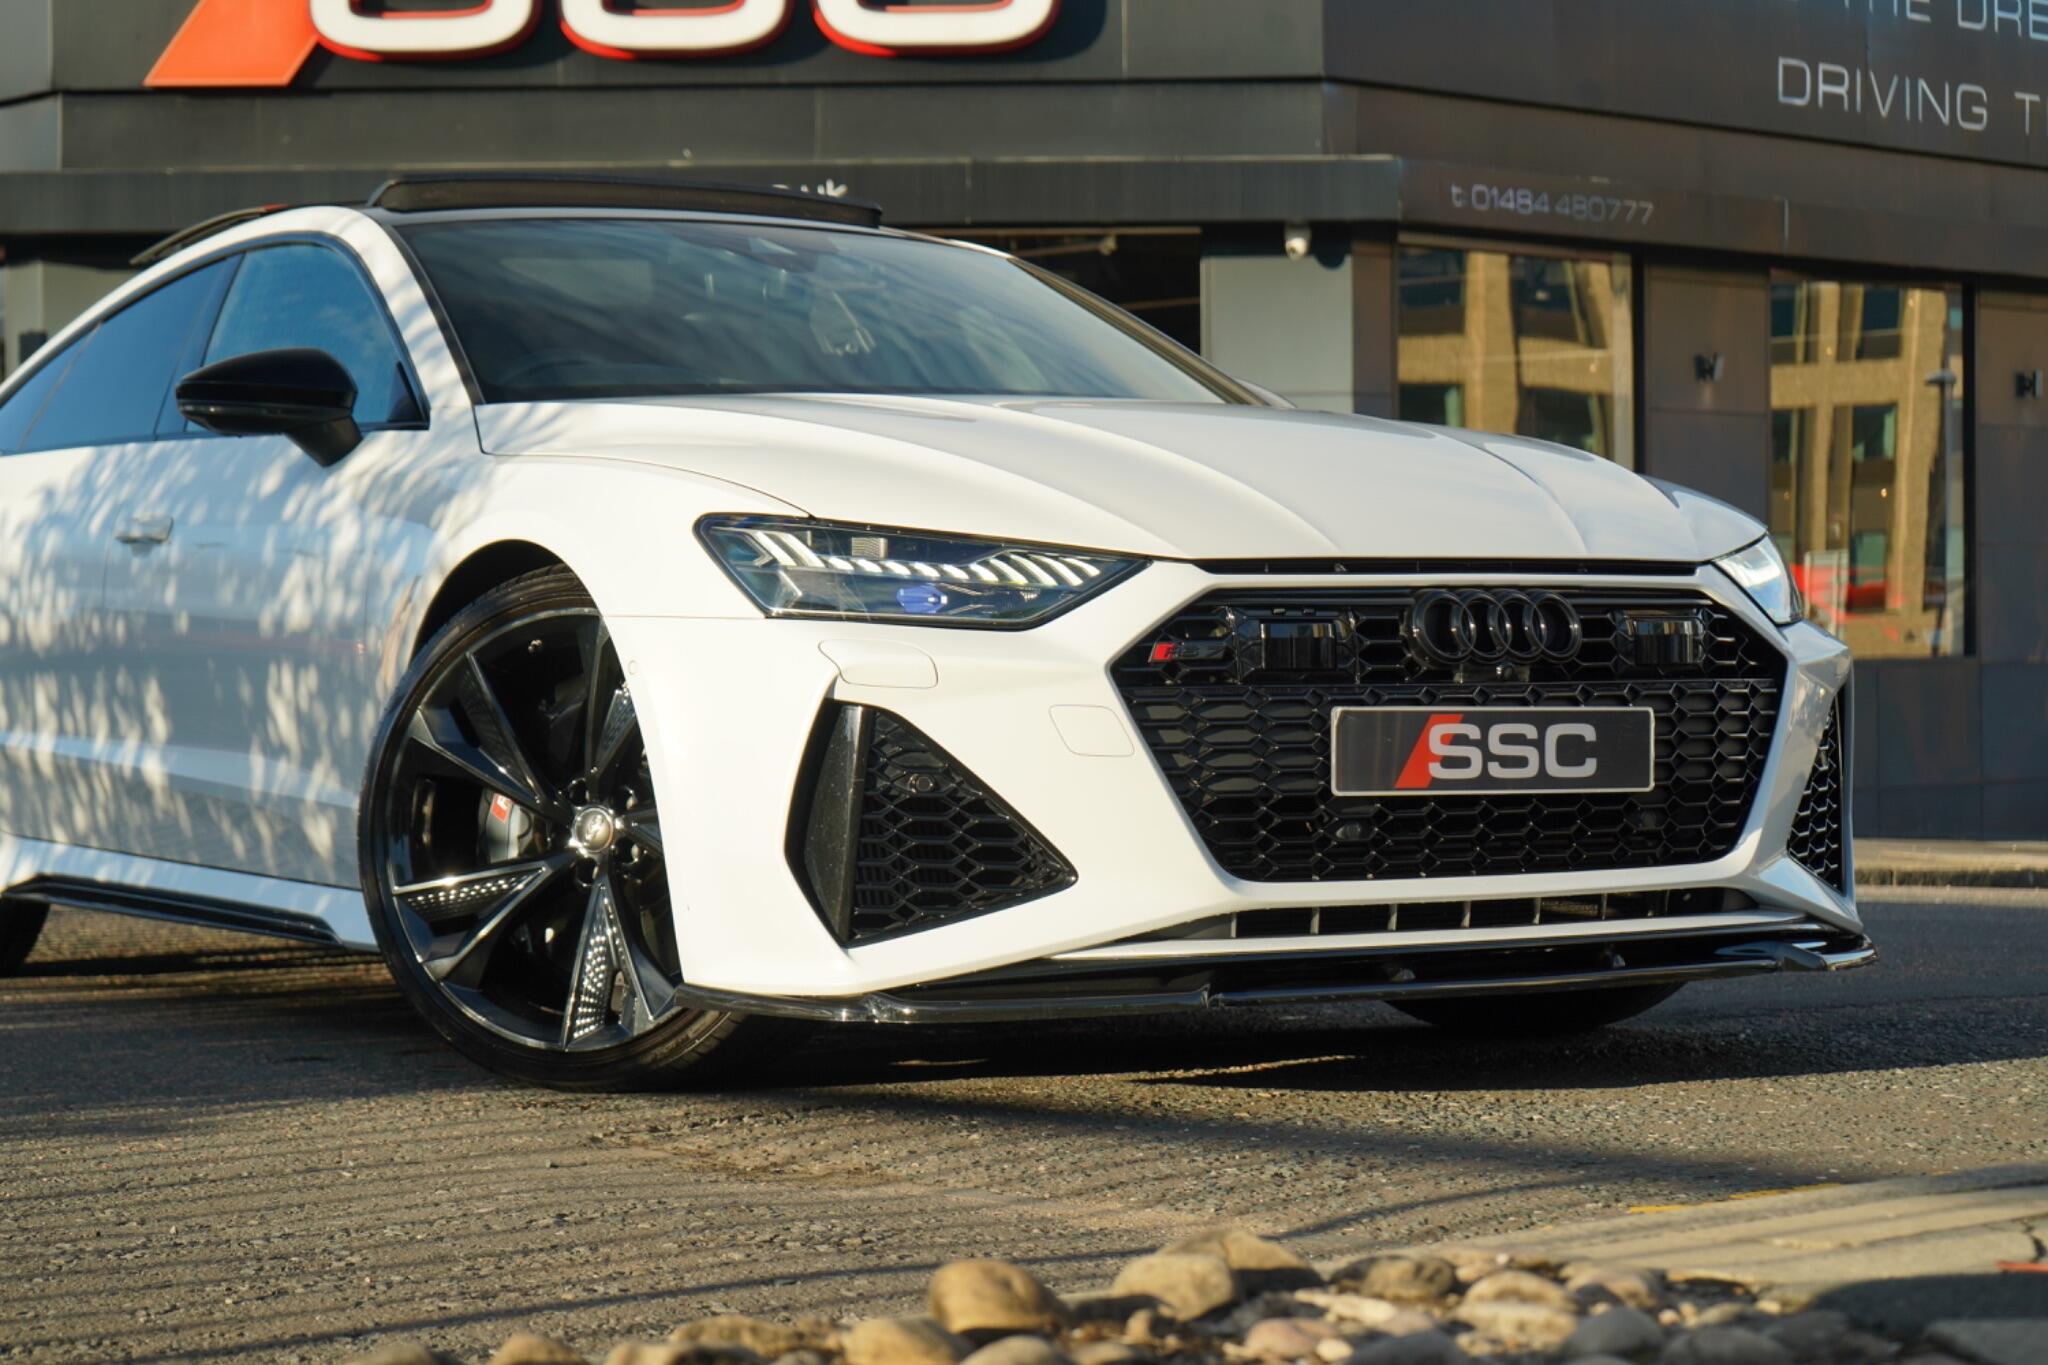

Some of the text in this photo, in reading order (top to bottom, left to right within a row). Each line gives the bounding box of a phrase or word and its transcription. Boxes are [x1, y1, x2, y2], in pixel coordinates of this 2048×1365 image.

[1778, 56, 1988, 131] DRIVING
[1471, 184, 1550, 215] 01484
[1555, 192, 1654, 225] 480777
[1428, 723, 1597, 779] SSC
